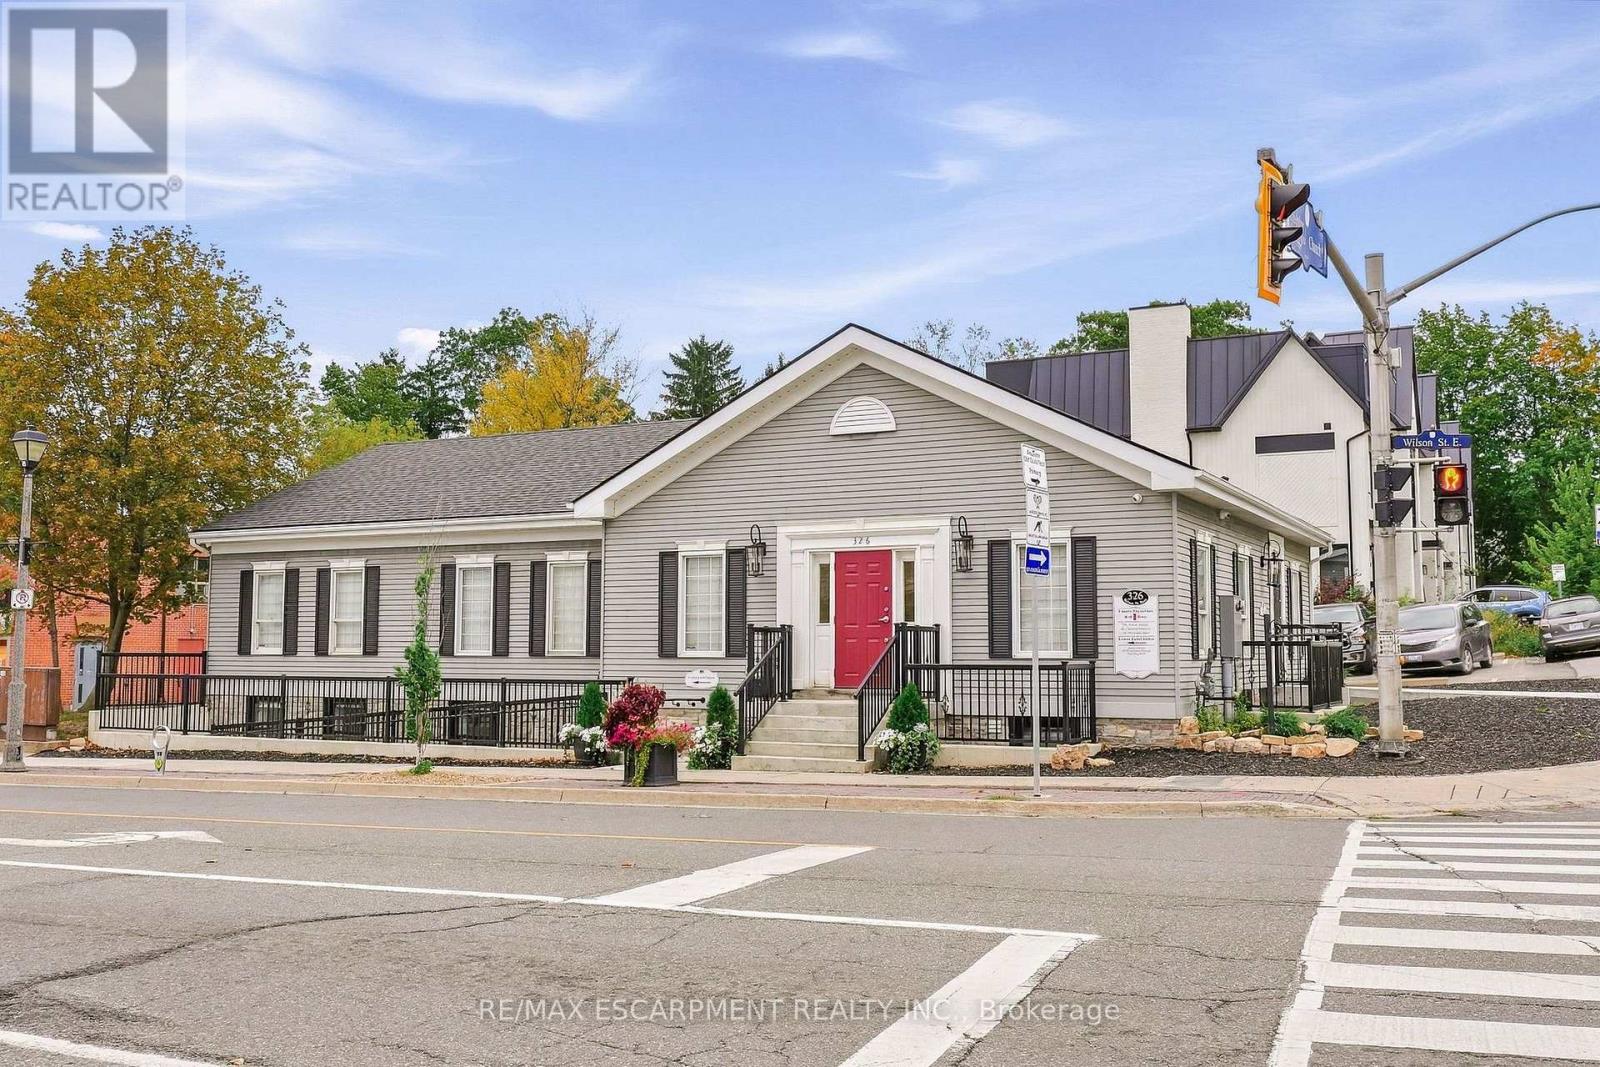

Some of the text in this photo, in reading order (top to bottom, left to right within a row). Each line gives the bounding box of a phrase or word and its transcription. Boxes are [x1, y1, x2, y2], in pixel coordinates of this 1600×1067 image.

[1402, 437, 1462, 447] Wilson St. E.
[852, 535, 871, 545] 326
[1126, 591, 1144, 600] 326
